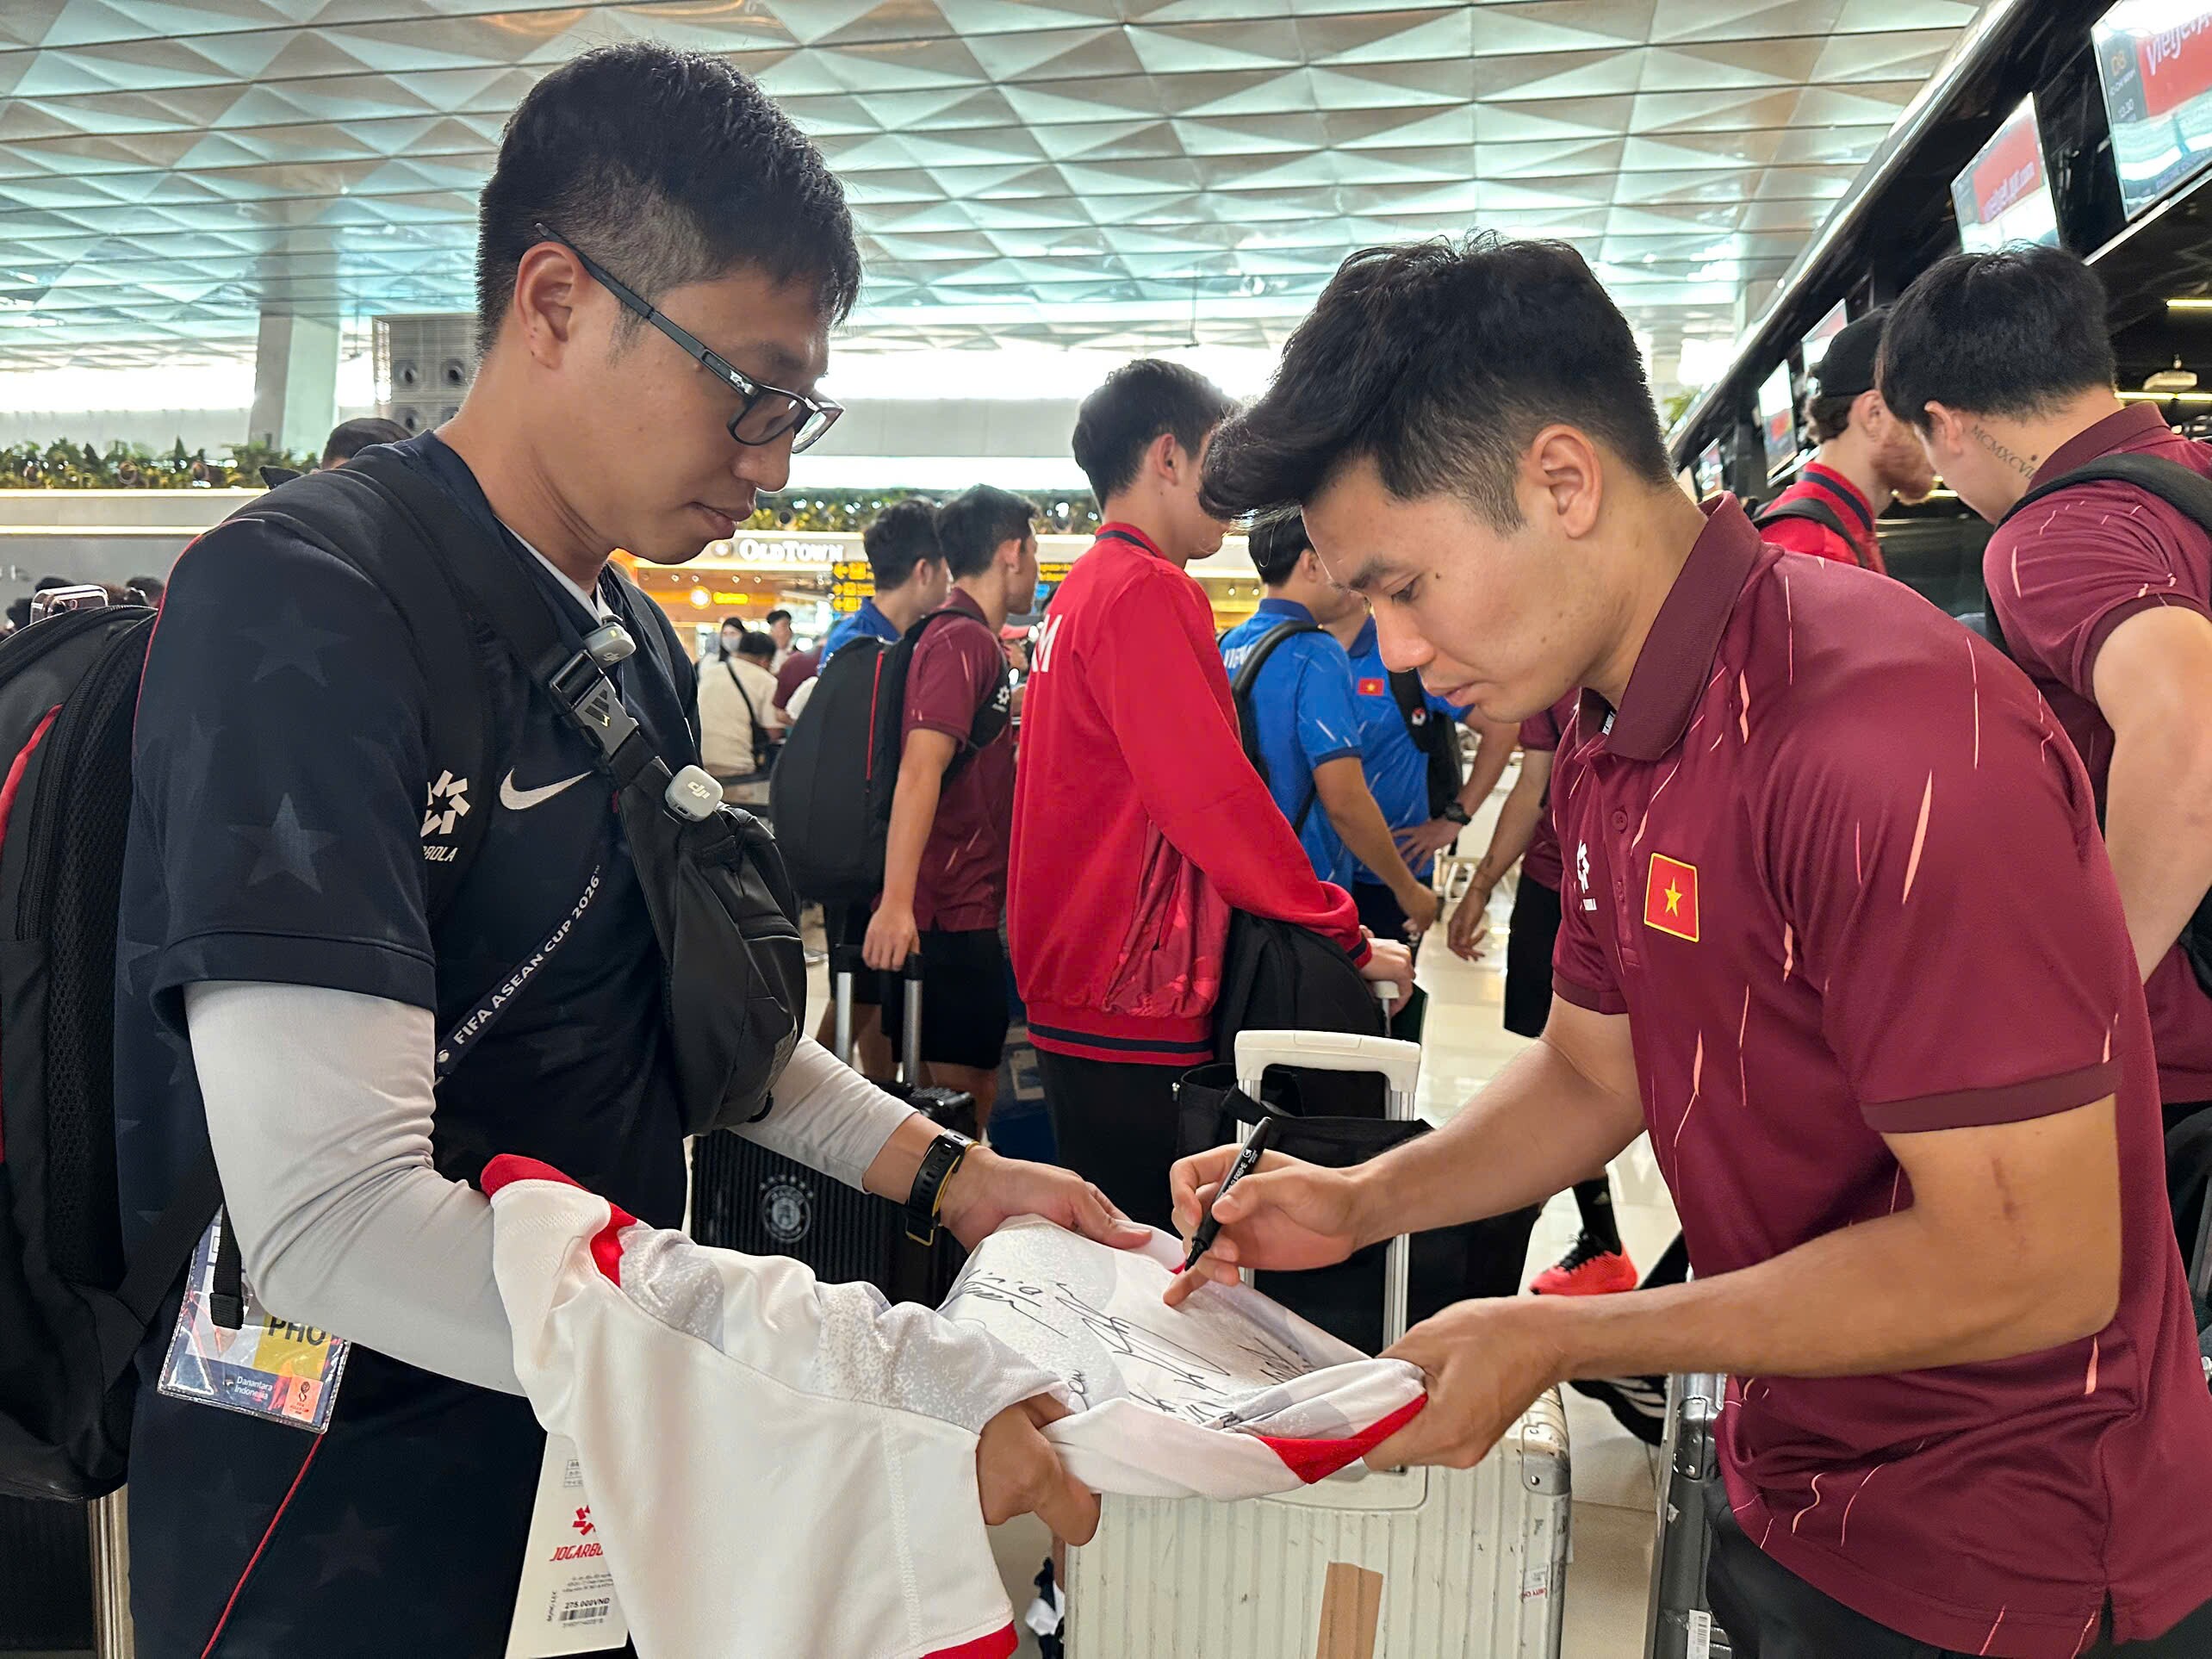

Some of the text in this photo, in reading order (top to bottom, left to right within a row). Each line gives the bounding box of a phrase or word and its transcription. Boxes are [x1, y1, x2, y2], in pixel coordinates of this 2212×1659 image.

[453, 1009, 494, 1045] FIFA
[491, 953, 544, 1010] ASEAN
[544, 919, 571, 952] CUP
[236, 1376, 273, 1392] Danantara
